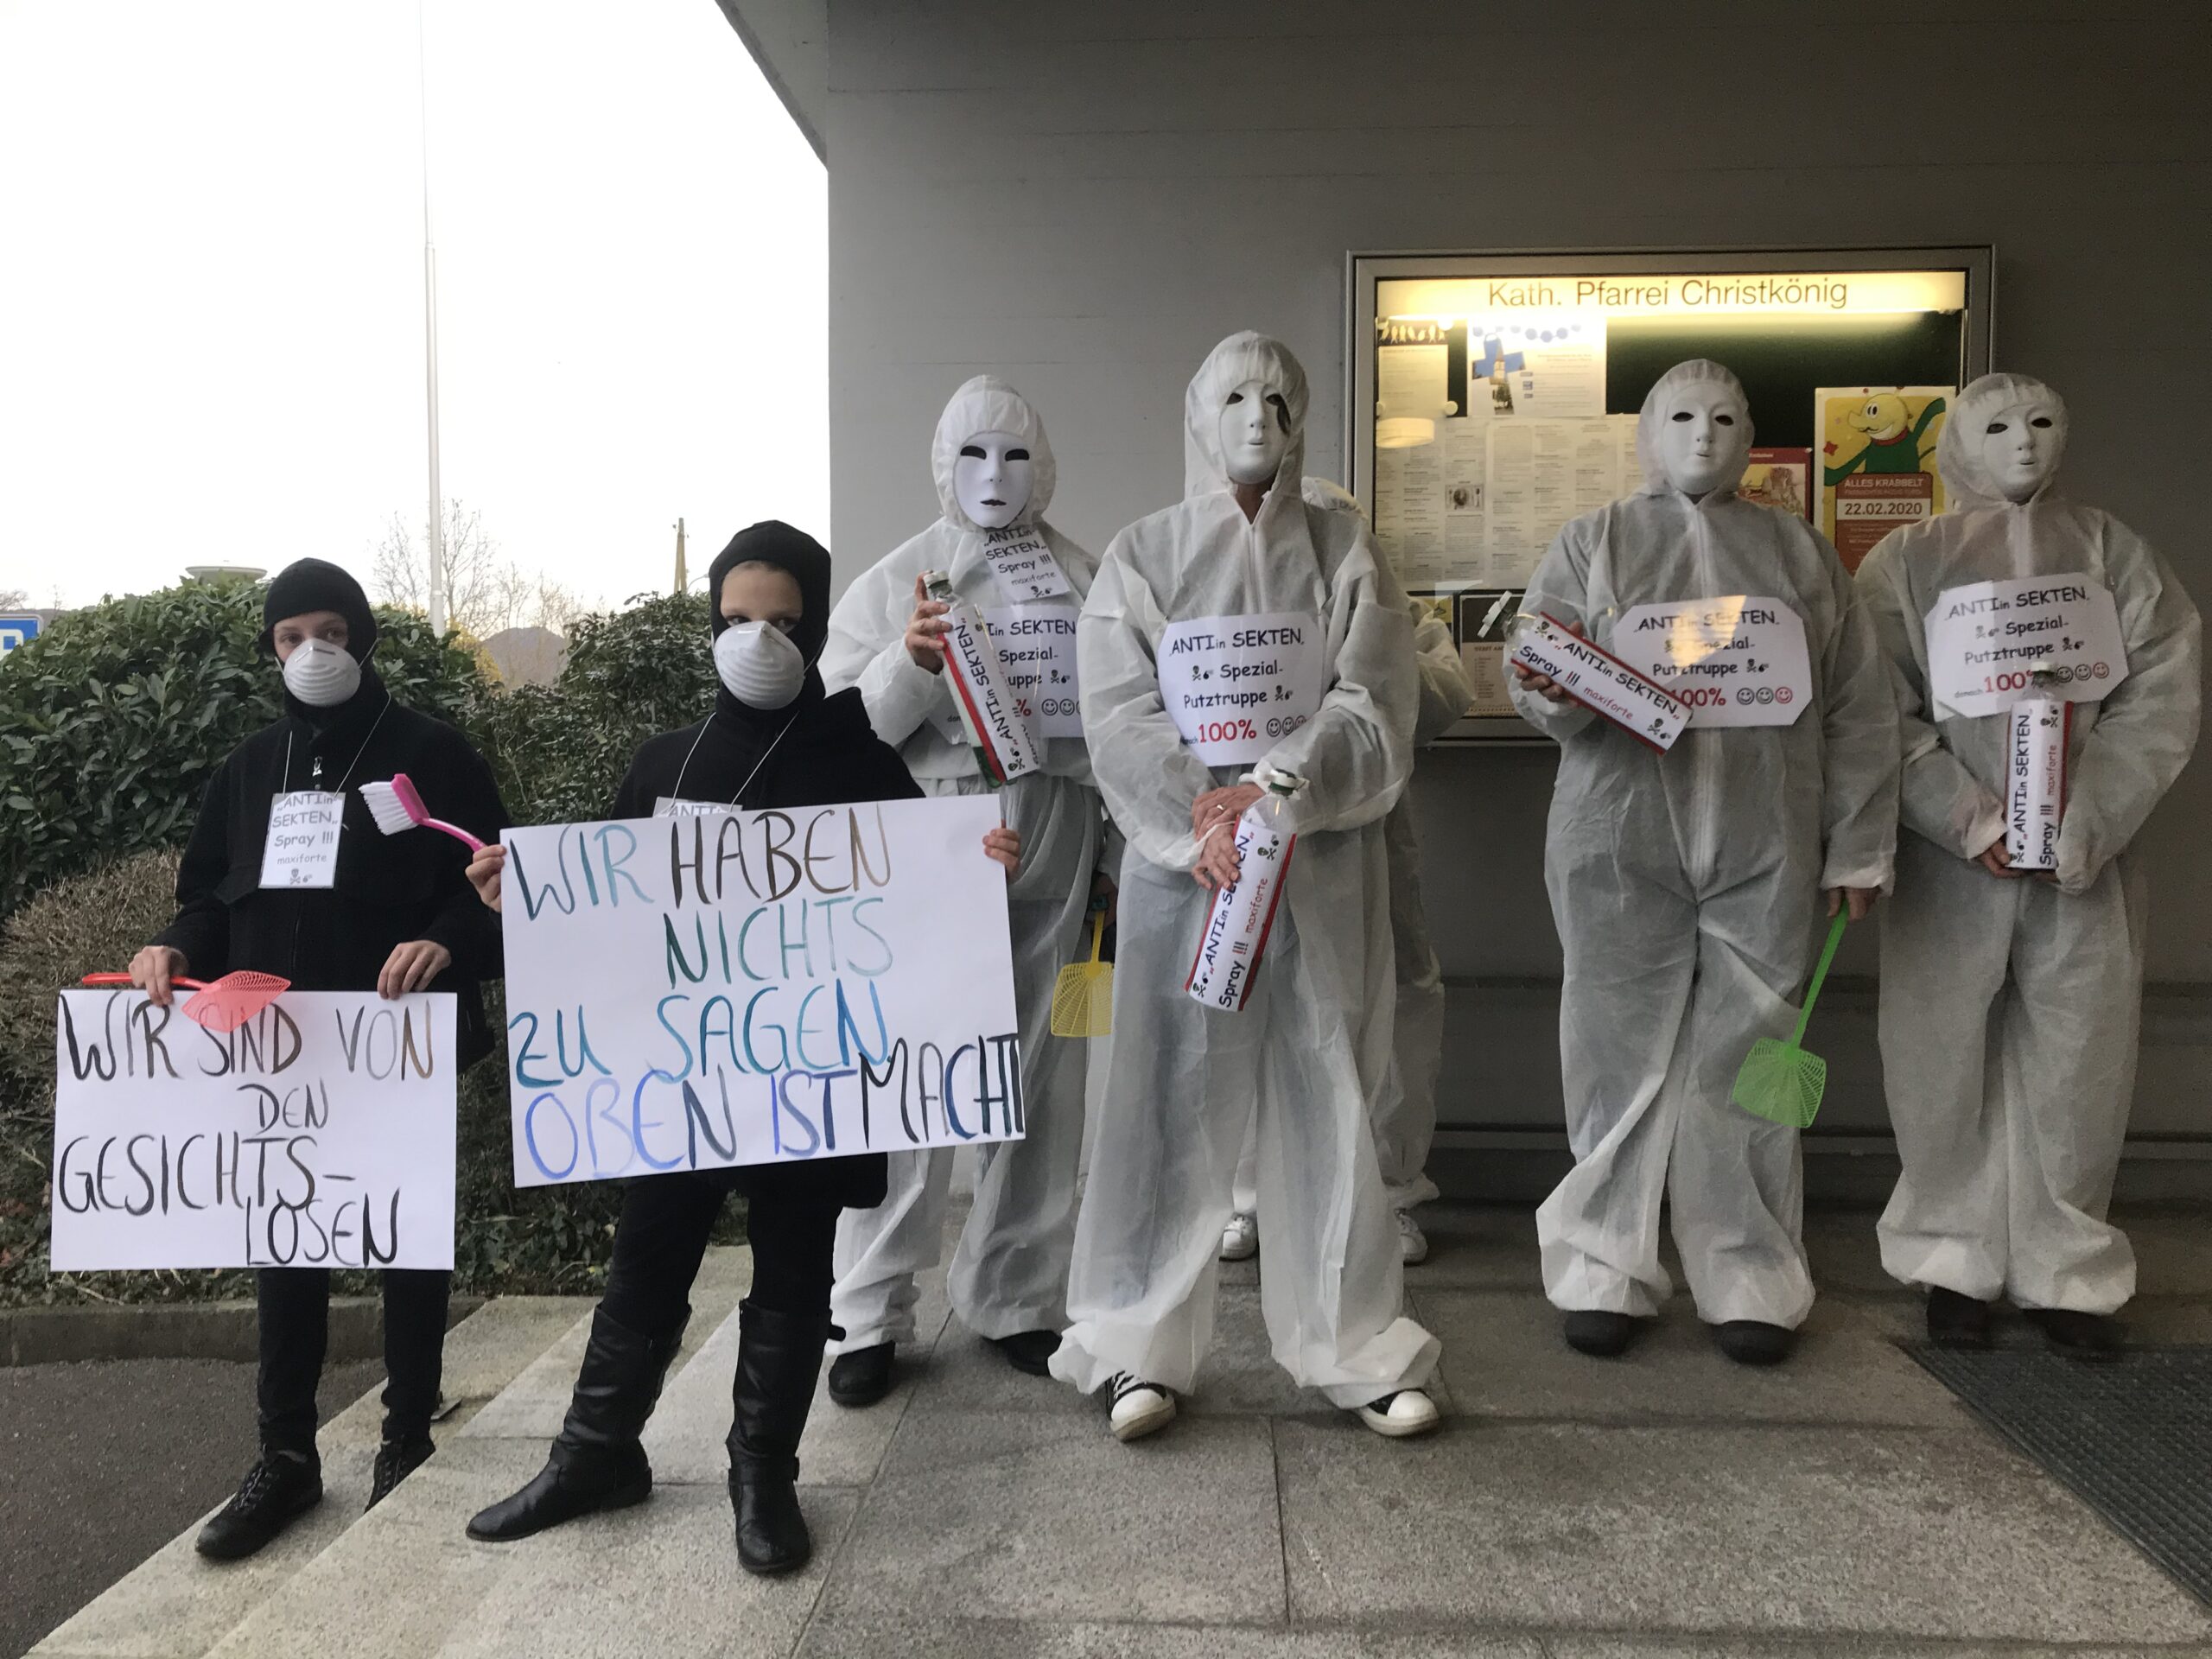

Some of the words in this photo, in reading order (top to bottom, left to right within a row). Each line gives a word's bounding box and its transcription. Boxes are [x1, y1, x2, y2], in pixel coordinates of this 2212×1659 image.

[1489, 281, 1561, 307] Kath.
[1577, 280, 1669, 306] Pfarrei
[1681, 277, 1847, 309] Christkönig
[1845, 479, 1873, 487] ALLES
[1875, 478, 1924, 487] KRABBELT
[1845, 503, 1923, 515] 22.02.2020
[998, 560, 1035, 574] Spray
[1011, 572, 1057, 585] maxiforte
[2005, 615, 2069, 637] Spezial-
[999, 646, 1058, 665] Spezial-
[1964, 643, 2055, 665] Putztruppe
[1219, 659, 1283, 682] Spezial-
[1519, 645, 1562, 677] Spray
[1583, 686, 1634, 721] maxiforte
[1183, 690, 1268, 709] Putztruppe
[1198, 718, 1257, 743] 100%
[2046, 744, 2057, 796] maxiforte
[275, 834, 315, 849] Spray
[2039, 822, 2057, 866] Spray
[276, 853, 327, 865] maxiforte
[508, 823, 655, 921] WIR
[671, 802, 892, 910] HABEN
[664, 896, 893, 990] NICHTS
[1219, 960, 1246, 1008] Spray
[1245, 877, 1268, 934] maxiforte
[59, 989, 186, 1081] WIR
[198, 1001, 302, 1077] SIND
[335, 998, 434, 1082] VON
[507, 1004, 613, 1088] ZU
[236, 1077, 329, 1135] DEN
[524, 1064, 737, 1180] OBEN
[770, 1068, 859, 1156] IST
[859, 1032, 1025, 1149] MACHT
[58, 1130, 357, 1216] GESICHTS-
[245, 1186, 401, 1268] LOSEN
